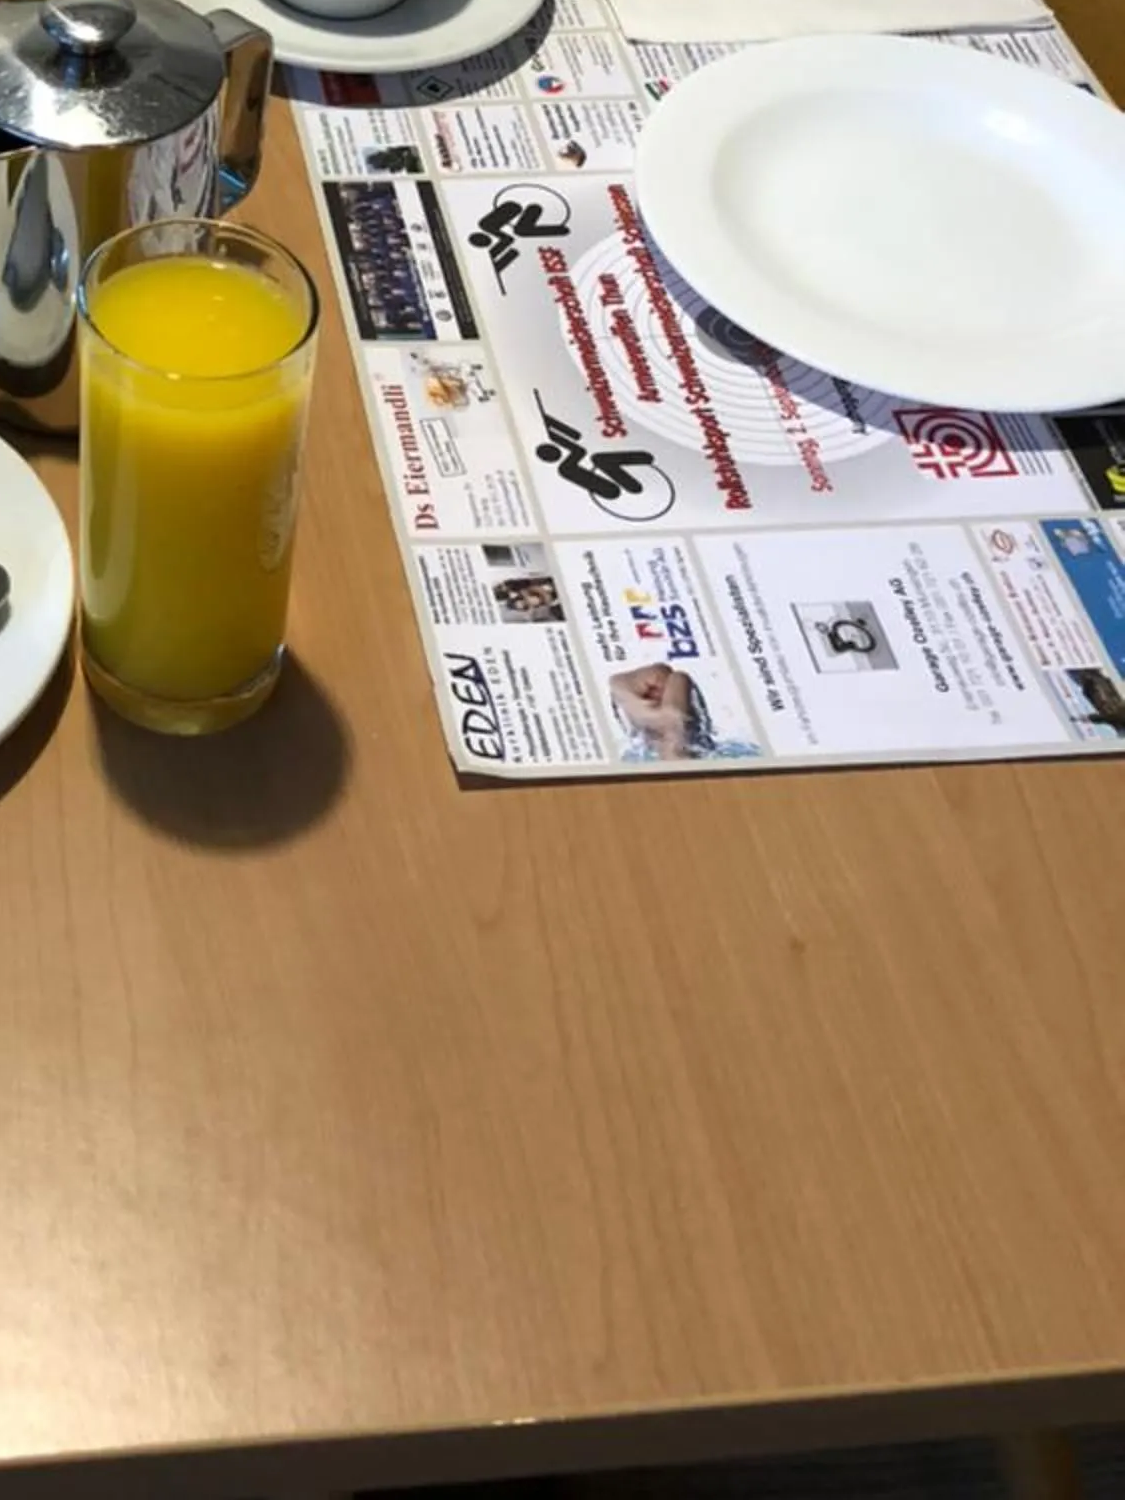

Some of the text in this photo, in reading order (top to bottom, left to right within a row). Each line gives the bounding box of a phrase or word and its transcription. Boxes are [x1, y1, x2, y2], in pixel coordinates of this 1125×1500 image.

[538, 246, 625, 436] Schweizermeisterschaft ISSF
[598, 273, 661, 402] Armeewaffen Thun
[607, 184, 750, 509] Rollstuhlsport Schweizermeisterschaft Schiessen
[380, 382, 438, 530] Ds Eiermandli
[661, 604, 700, 662] bzs
[725, 575, 784, 711] Wir sind Spezialisten
[888, 577, 906, 596] AG
[444, 652, 505, 762] EDEN
[922, 646, 949, 692] Garage
